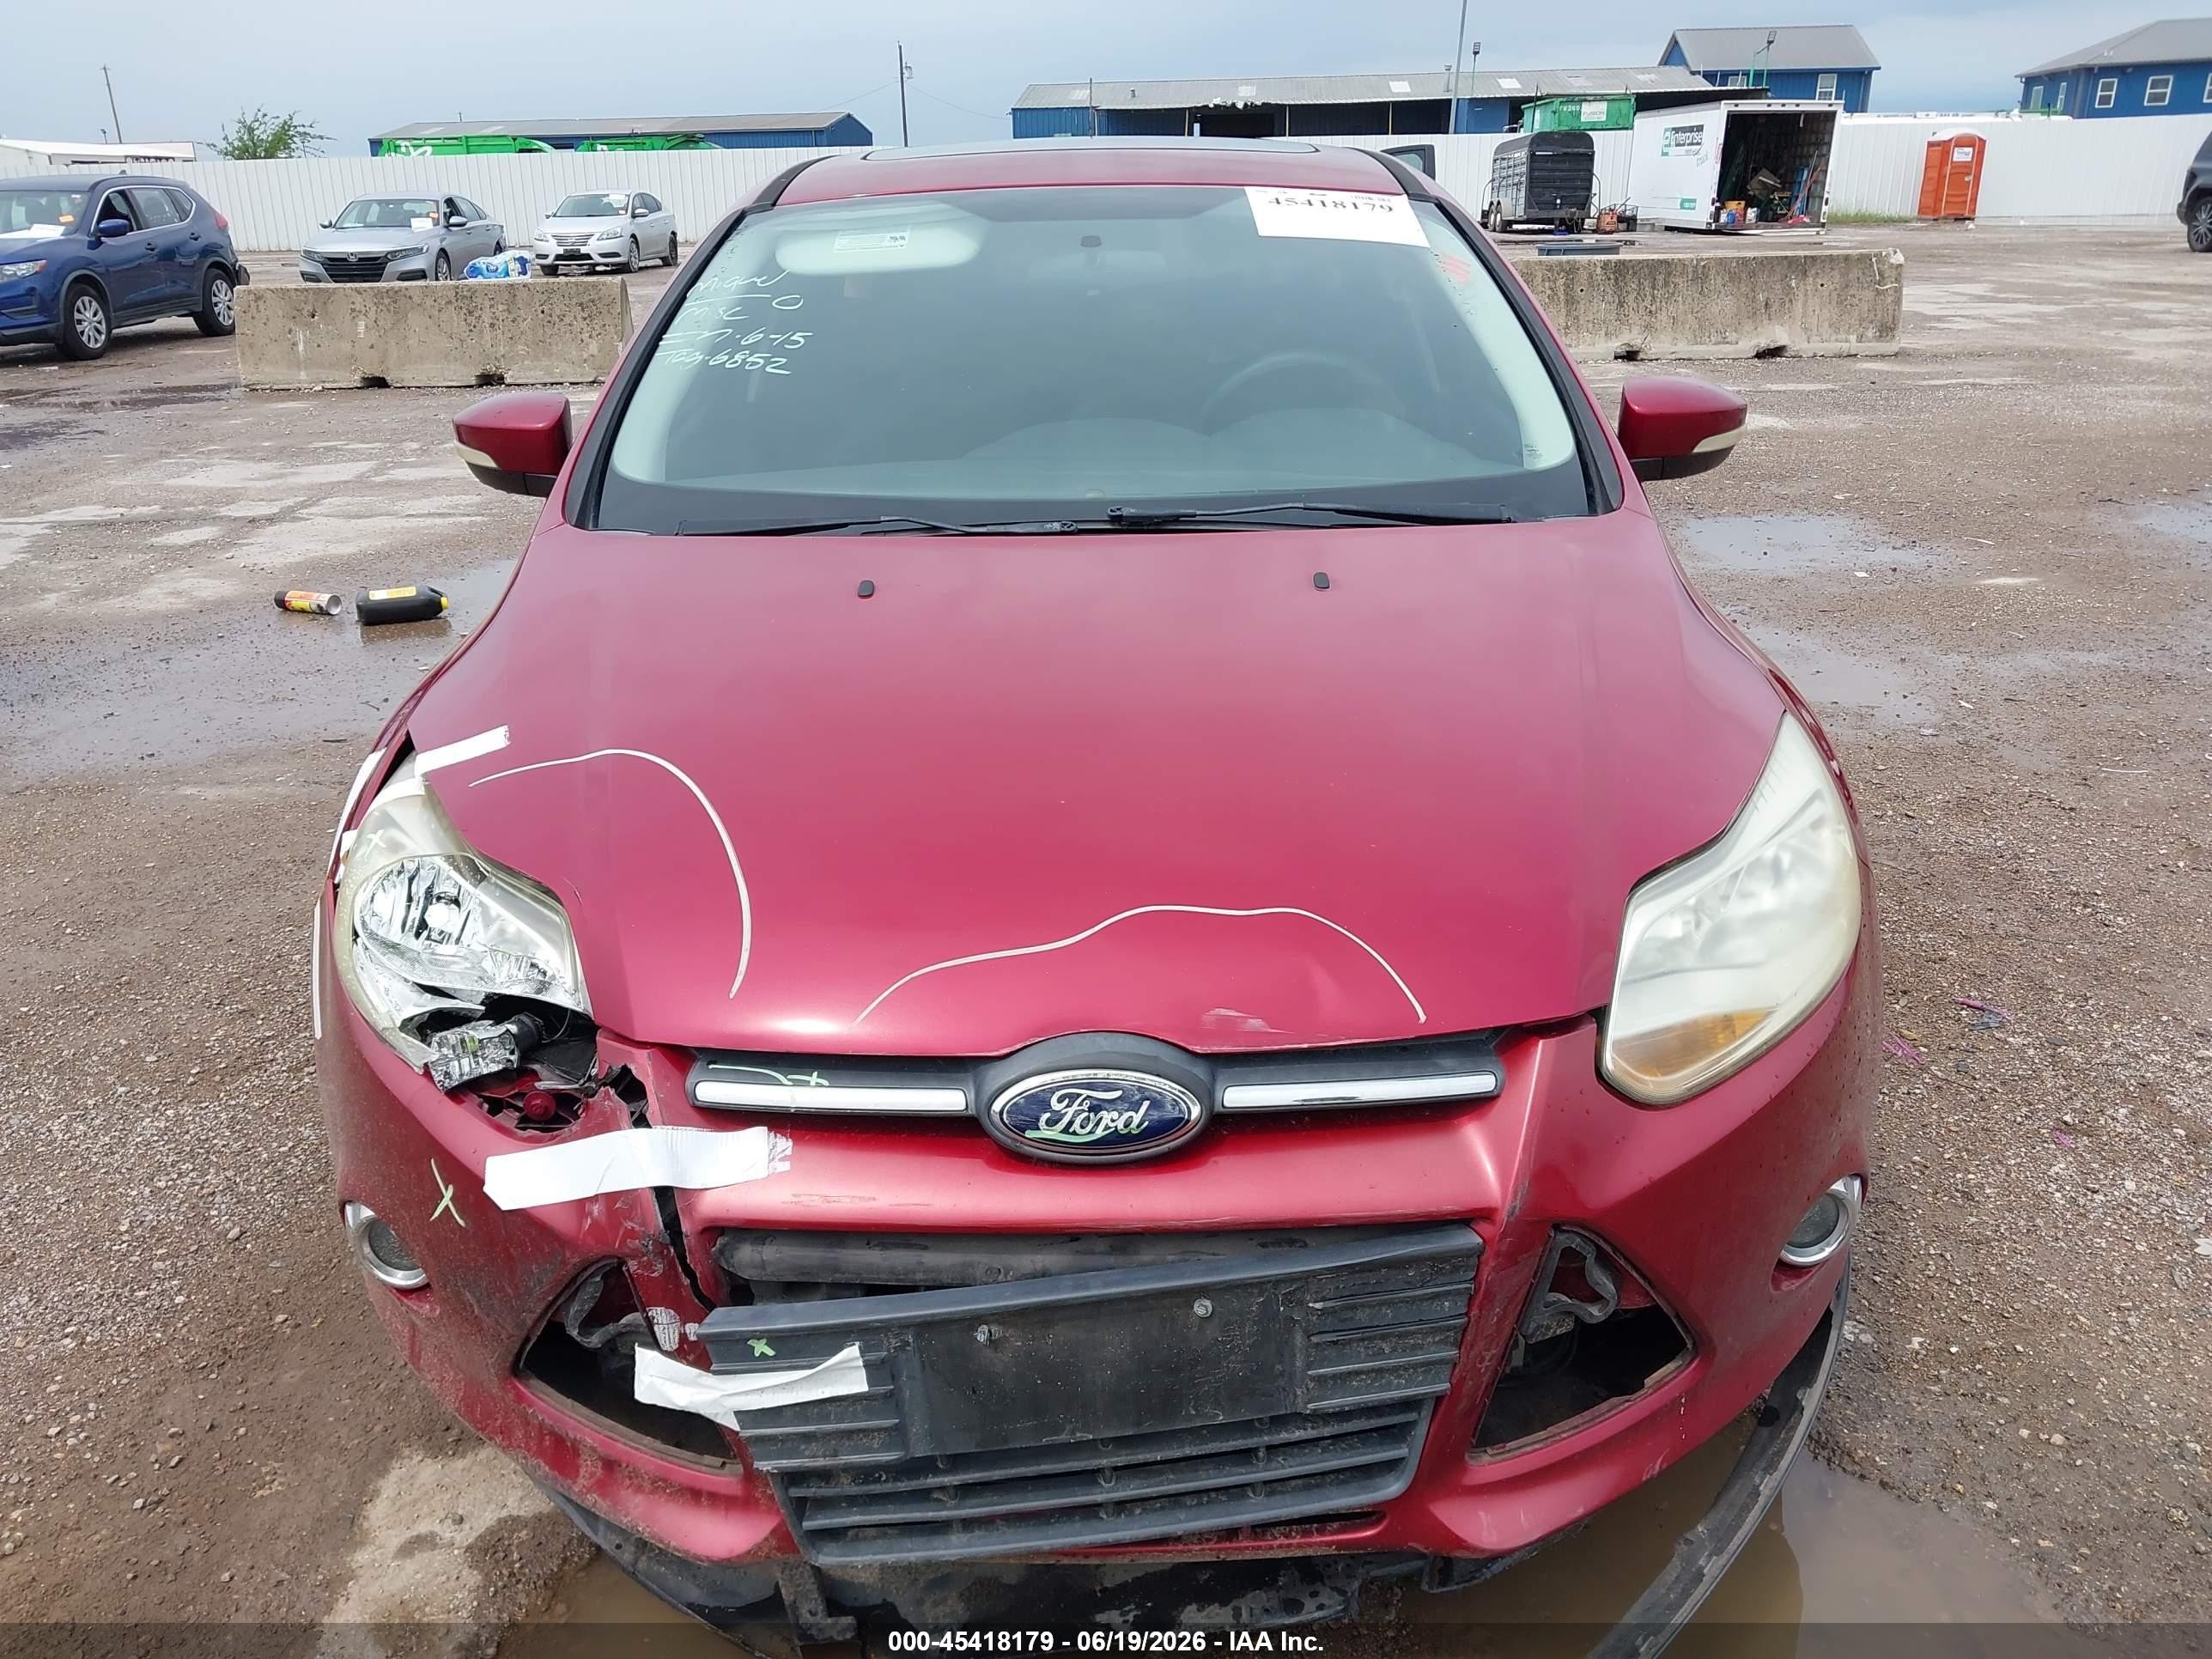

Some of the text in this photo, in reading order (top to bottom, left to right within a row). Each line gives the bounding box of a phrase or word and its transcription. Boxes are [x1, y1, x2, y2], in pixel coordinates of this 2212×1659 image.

[1670, 126, 1704, 147] Enterprise
[1267, 196, 1395, 213] 45418179
[1038, 1087, 1152, 1136] Ford
